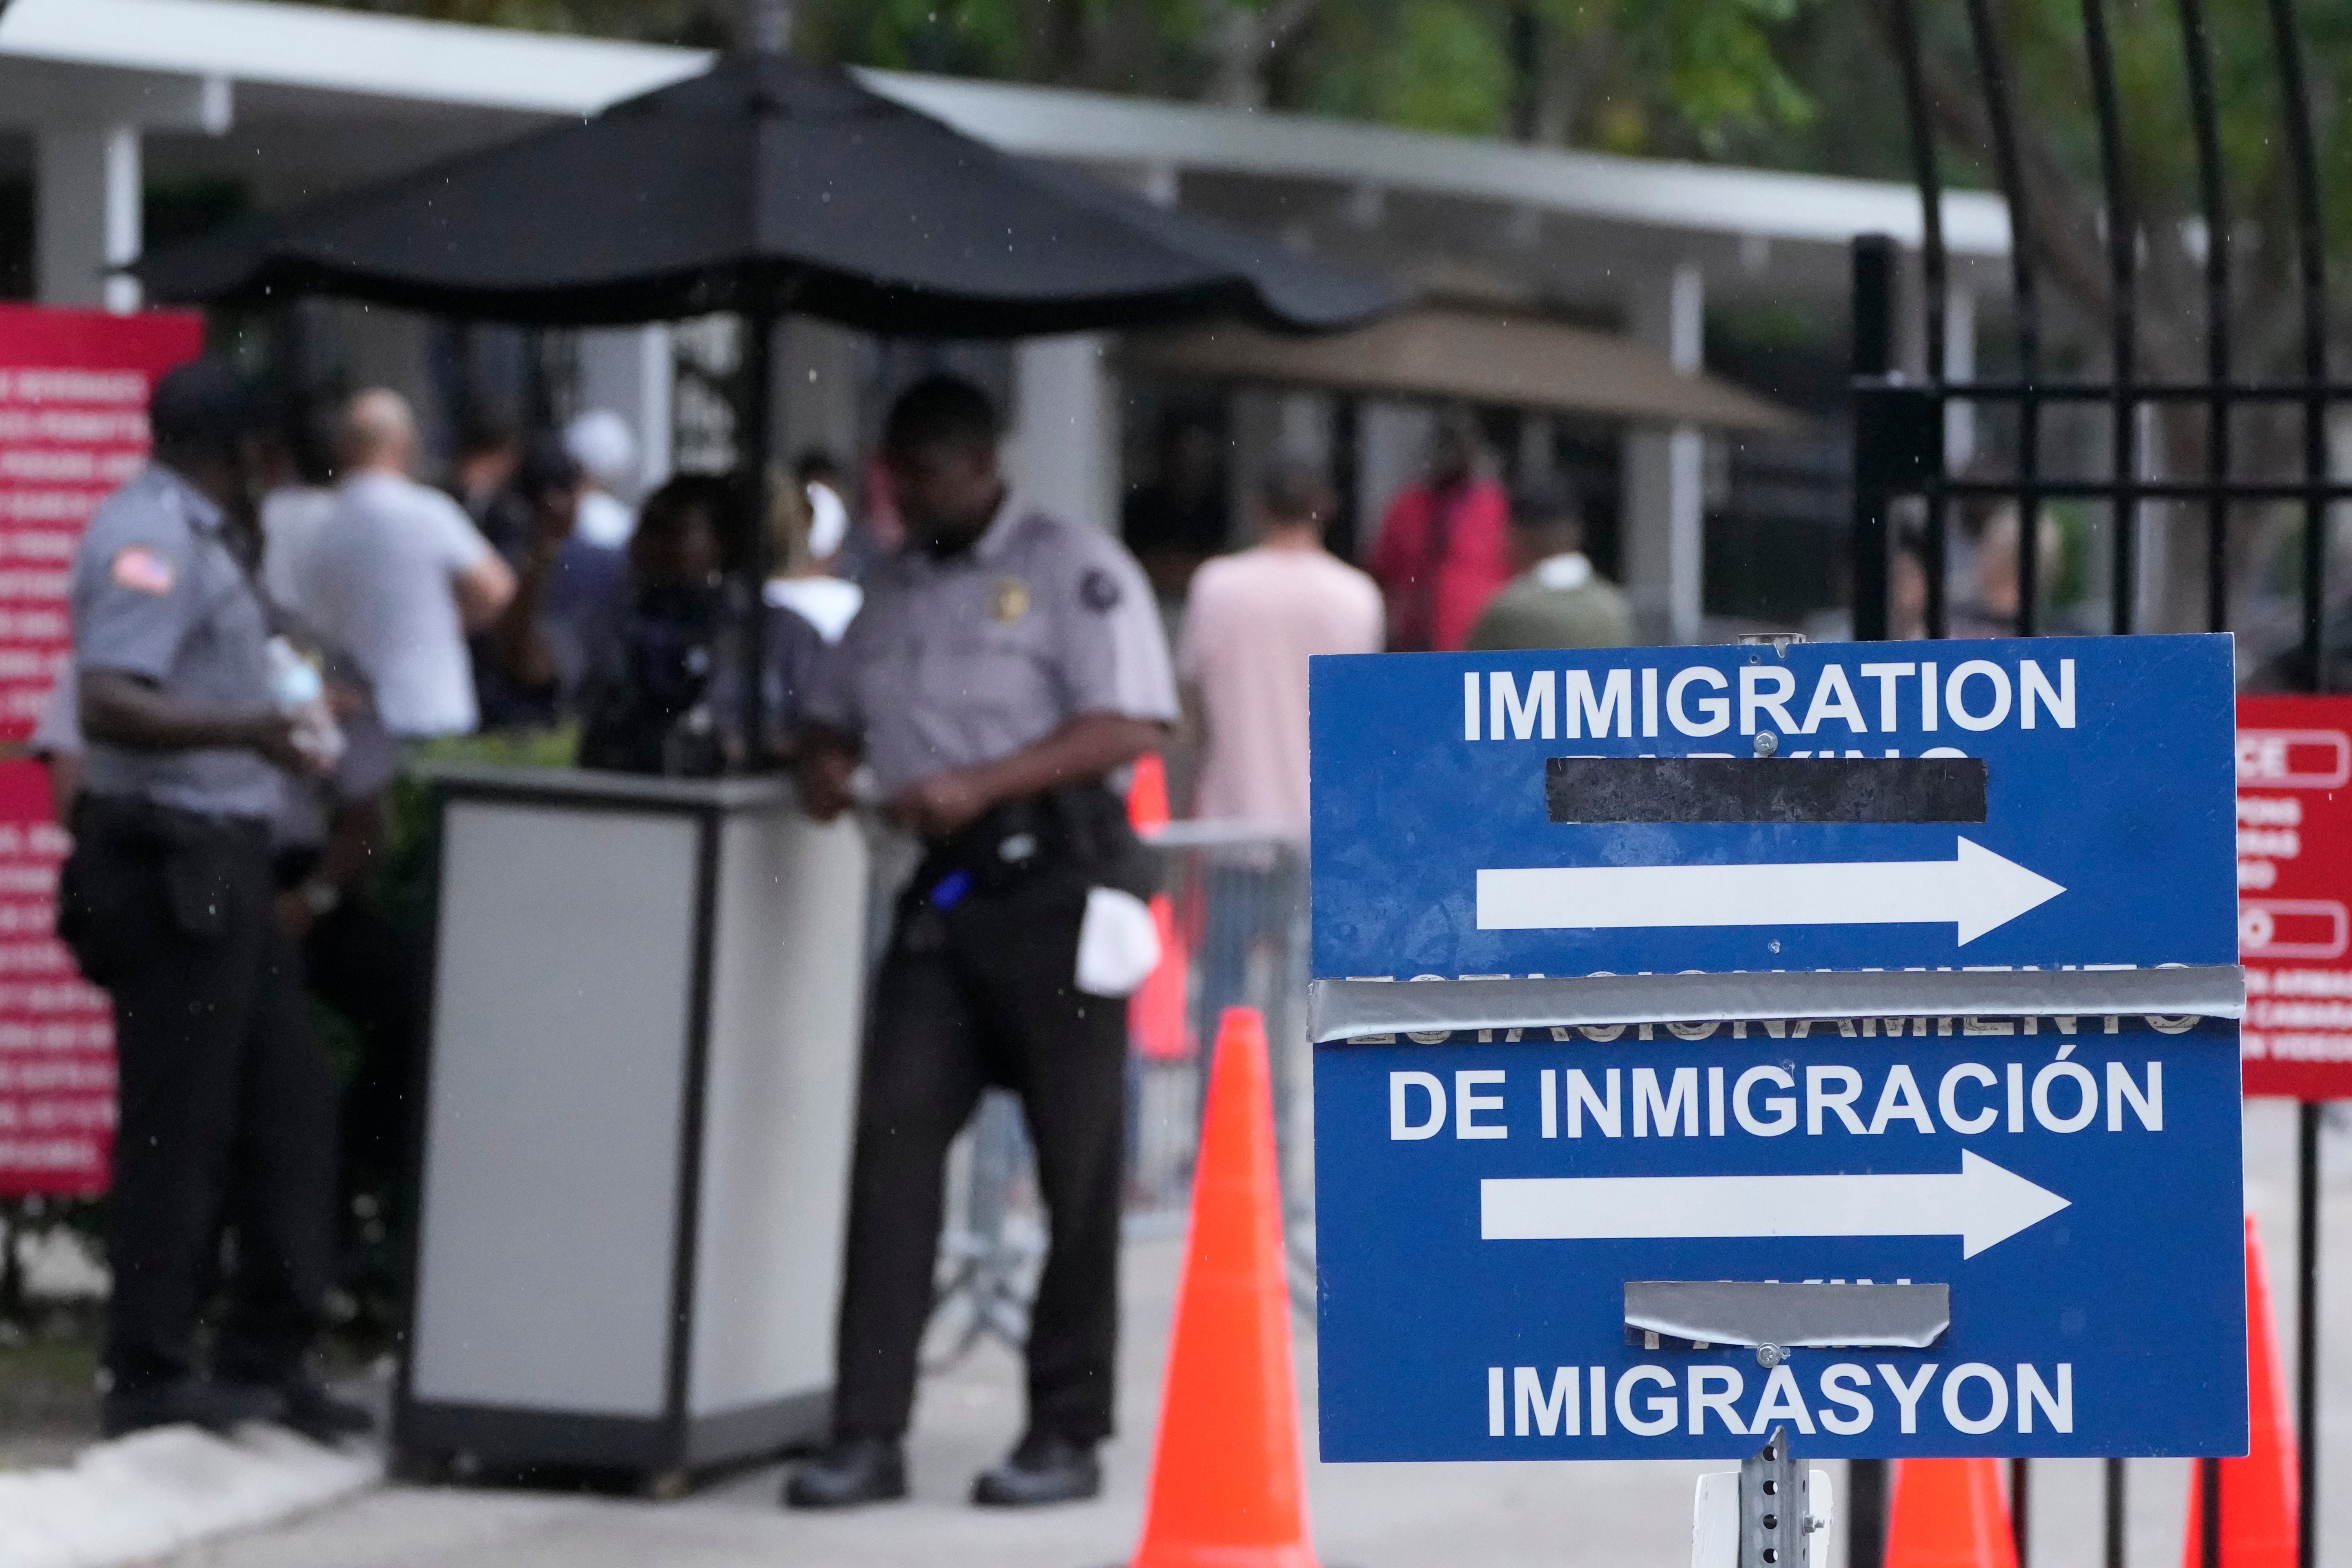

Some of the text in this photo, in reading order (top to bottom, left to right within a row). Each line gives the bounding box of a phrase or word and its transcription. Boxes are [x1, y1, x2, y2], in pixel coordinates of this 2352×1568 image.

[1464, 659, 2076, 741] IMMIGRATION
[1390, 1044, 2163, 1141] DE INMIGRACIÓN
[1488, 1362, 2073, 1437] IMIGRASYON
